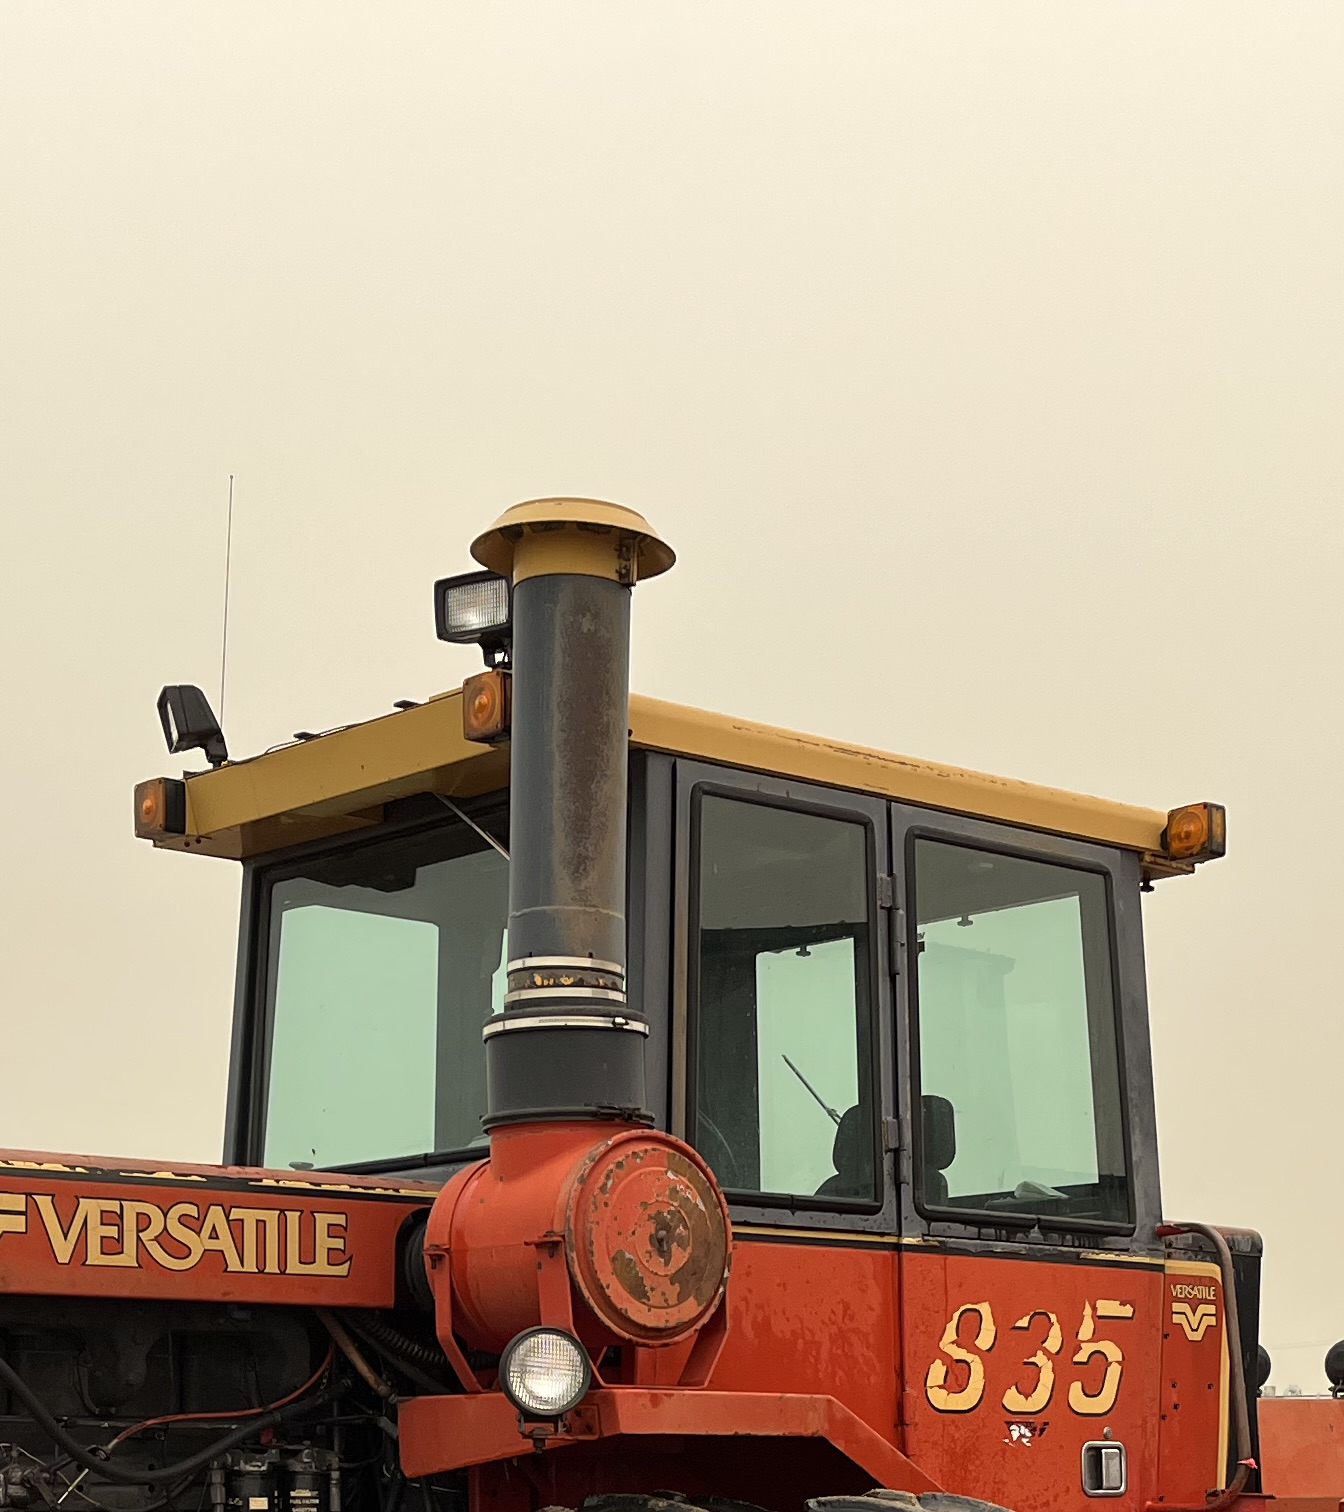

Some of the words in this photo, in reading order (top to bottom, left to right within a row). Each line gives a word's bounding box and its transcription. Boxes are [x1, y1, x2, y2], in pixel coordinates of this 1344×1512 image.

[30, 1193, 353, 1277] VERSATILE
[1170, 1284, 1216, 1300] VERSATILE
[925, 1299, 1135, 1416] 835
